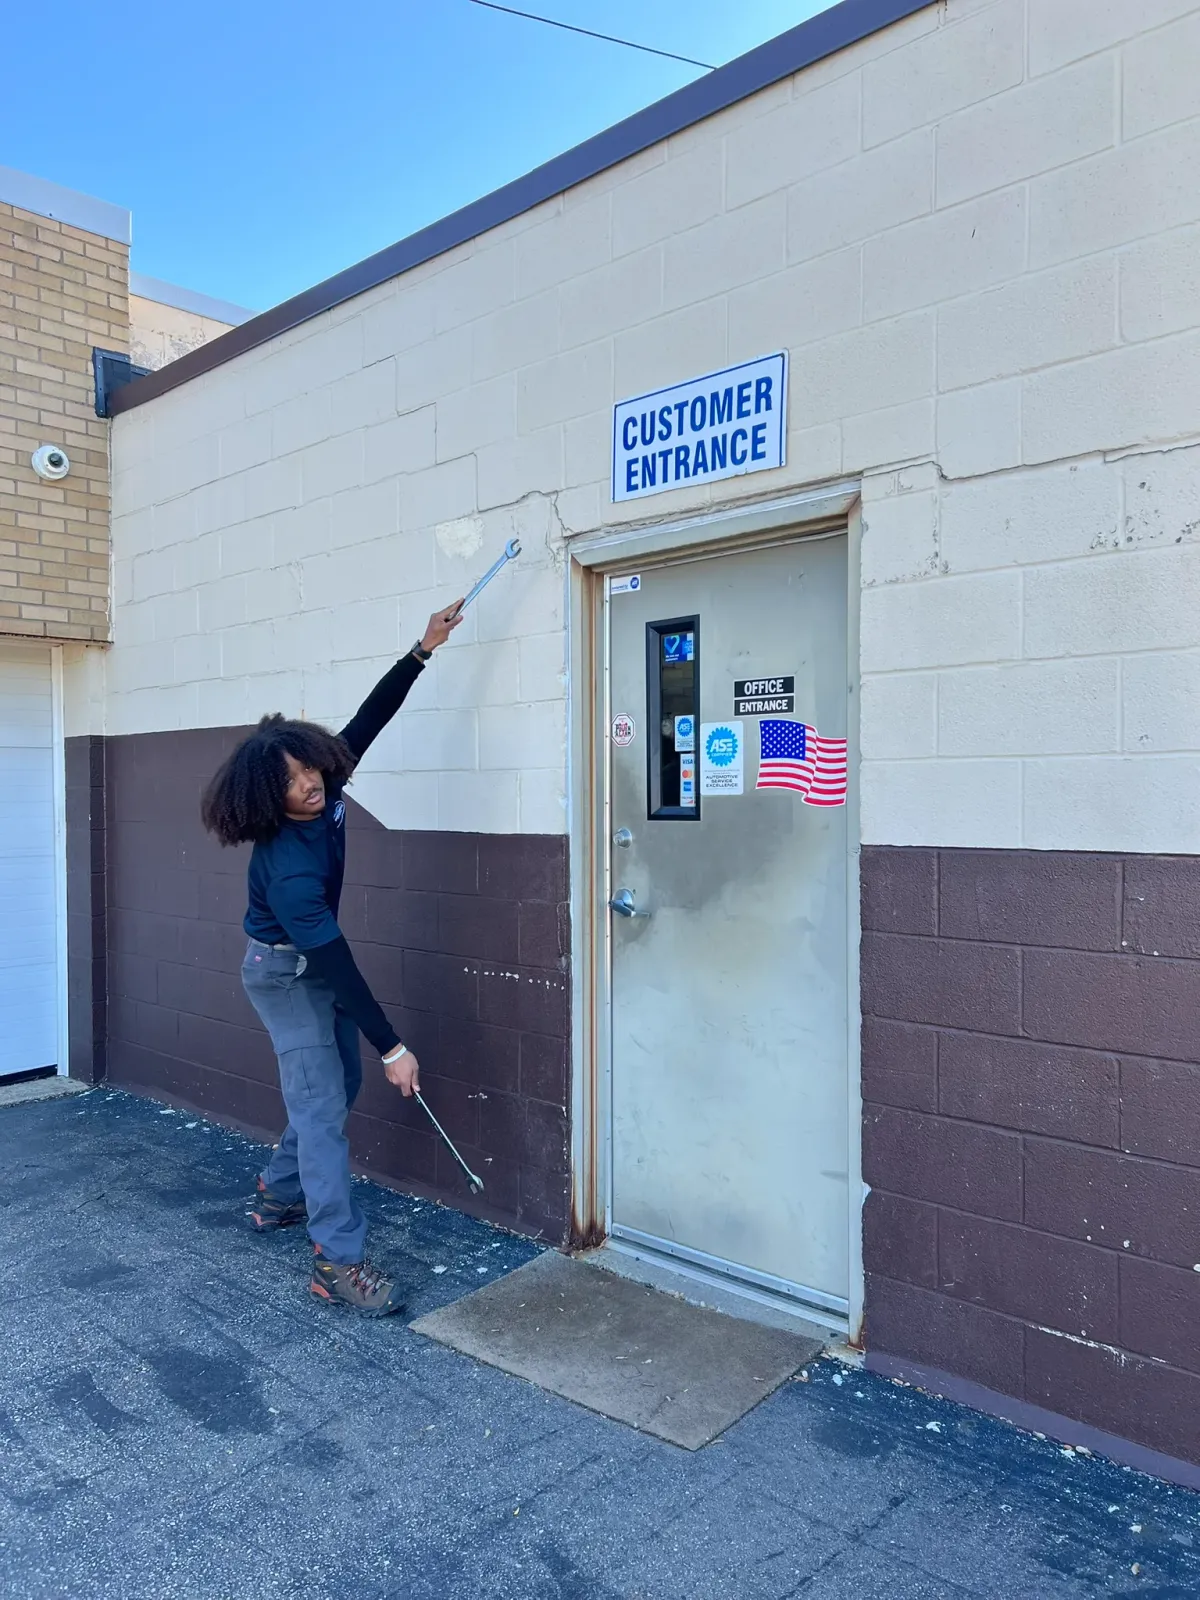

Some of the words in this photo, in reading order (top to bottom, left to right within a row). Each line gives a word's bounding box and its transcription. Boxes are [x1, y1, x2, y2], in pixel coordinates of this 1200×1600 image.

[622, 376, 773, 451] CUSTOMER
[626, 422, 767, 492] ENTRANCE
[744, 679, 784, 695] OFFICE
[740, 699, 788, 713] ENTRANCE
[710, 738, 733, 752] ASE
